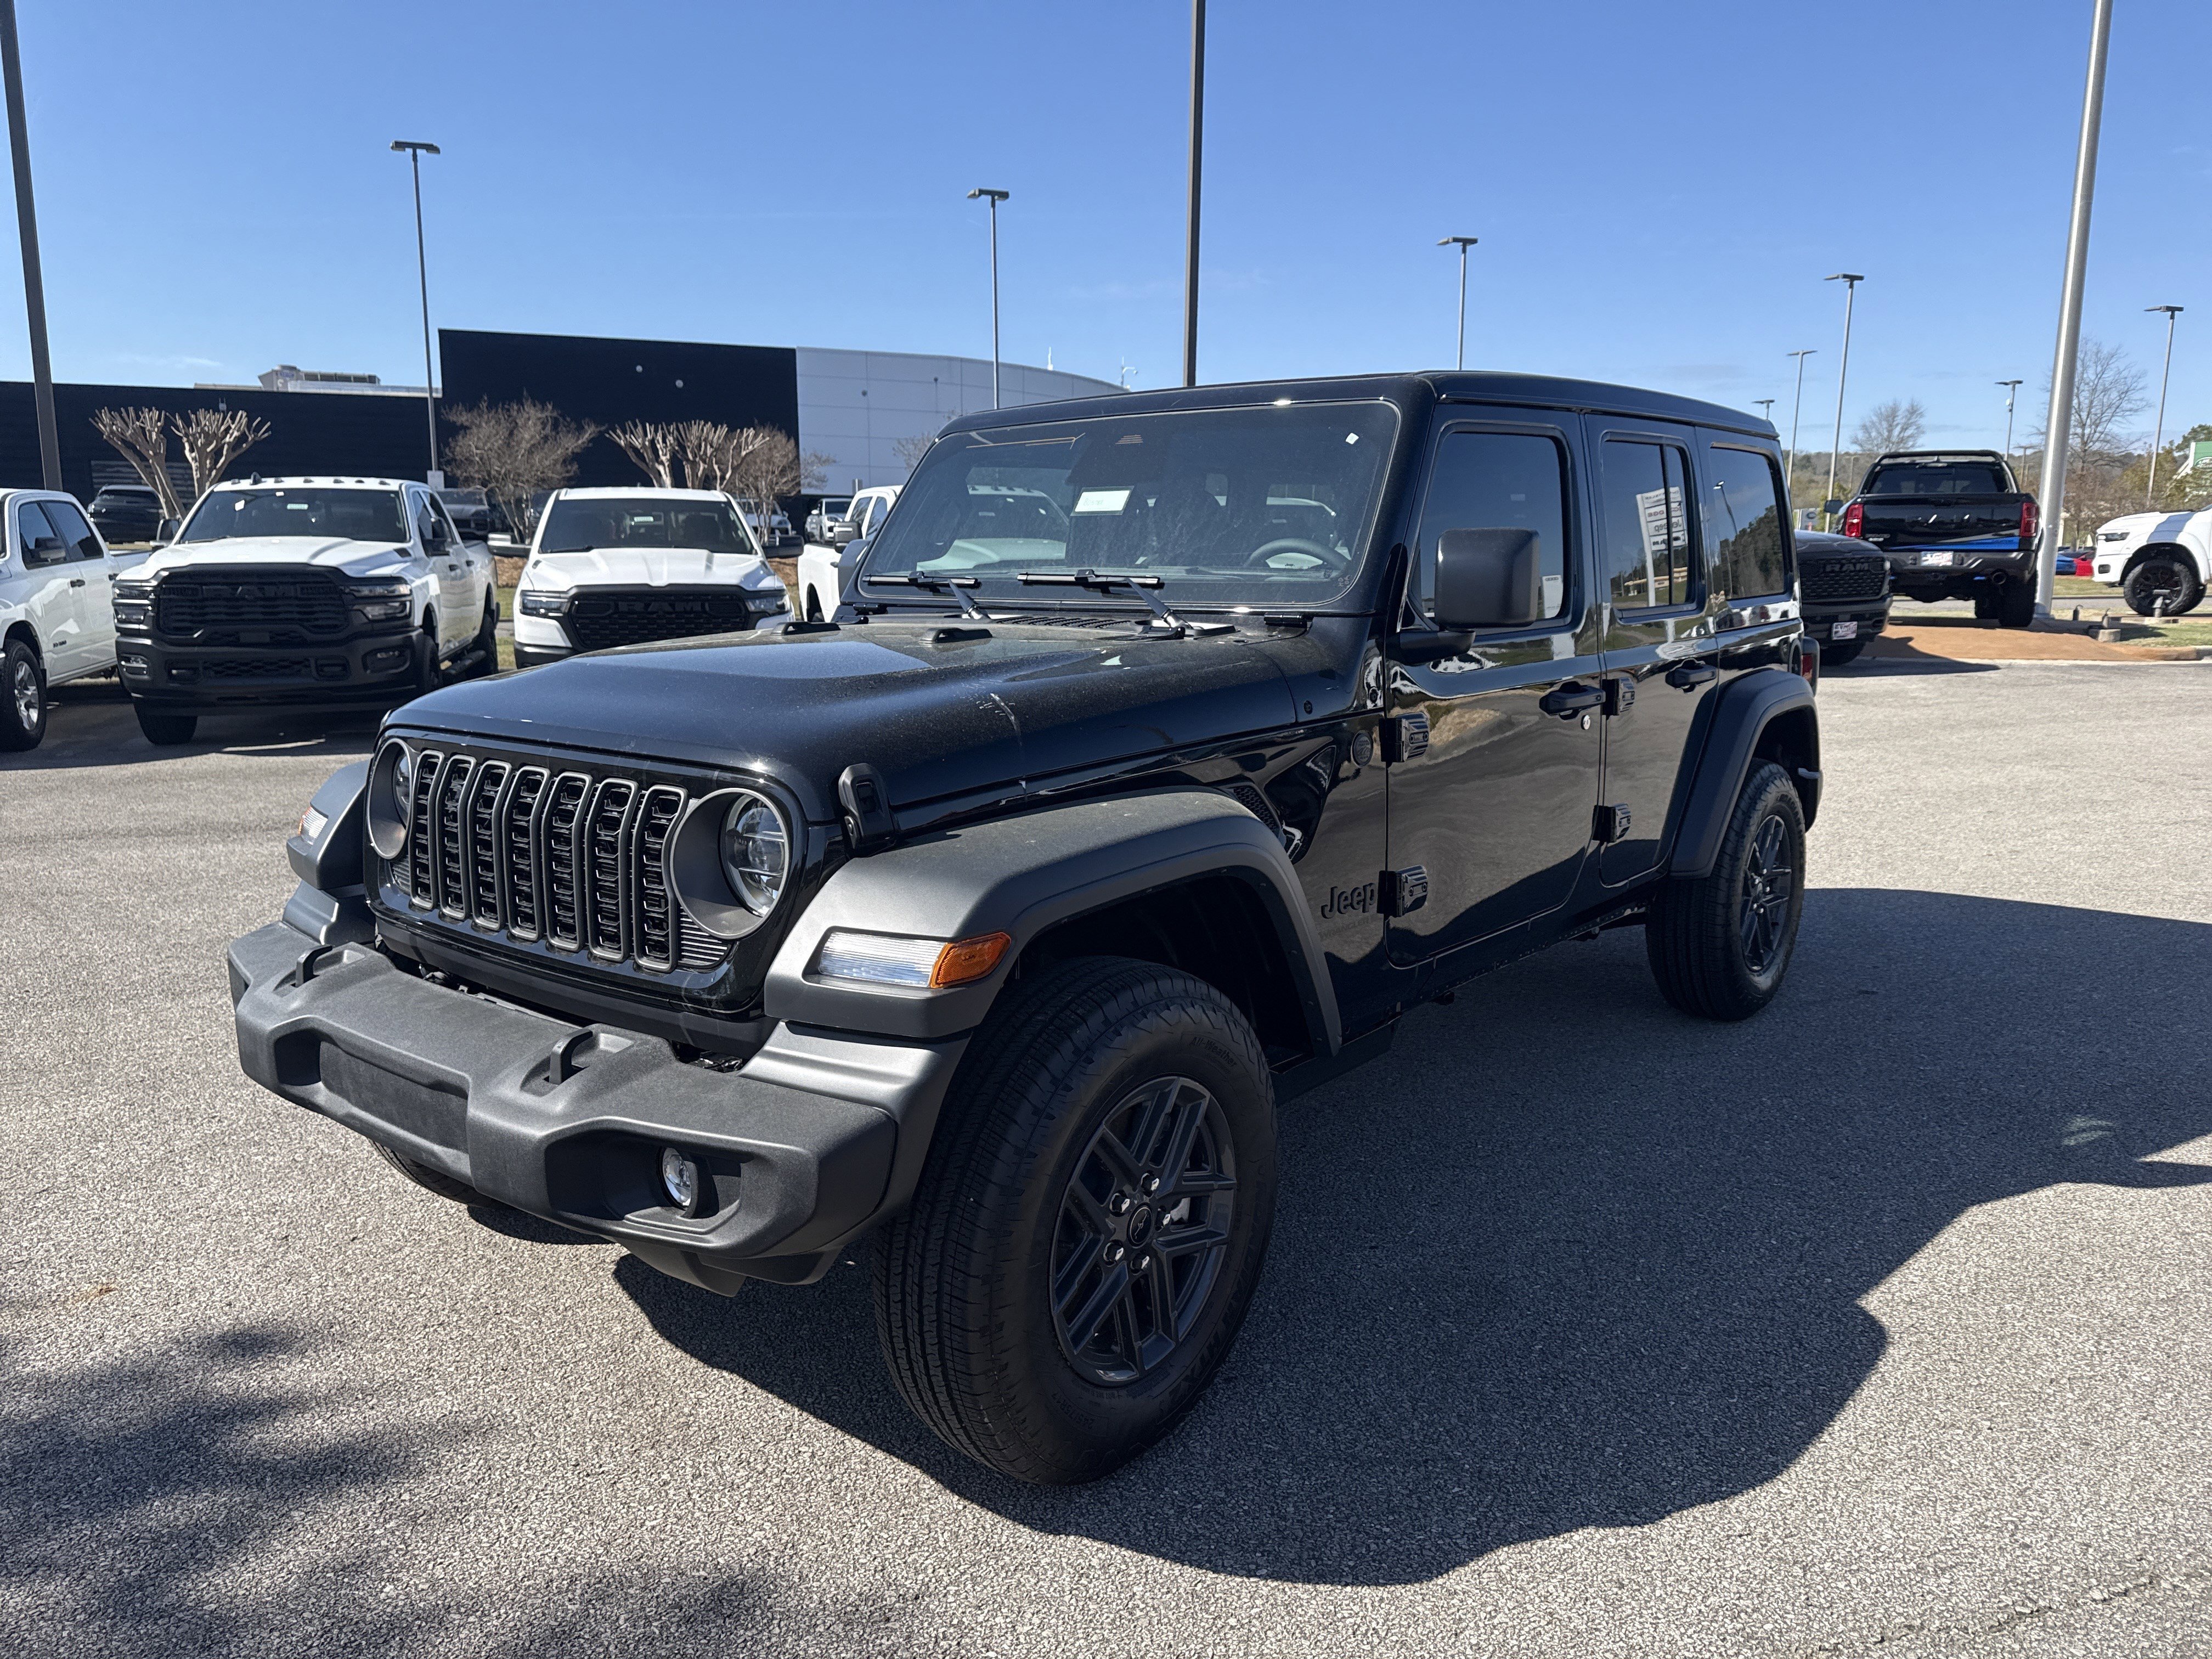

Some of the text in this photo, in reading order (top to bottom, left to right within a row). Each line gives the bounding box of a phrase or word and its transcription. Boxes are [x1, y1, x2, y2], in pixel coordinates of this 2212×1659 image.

[1826, 563, 1869, 571] RAM
[618, 602, 702, 612] RAM
[1321, 883, 1376, 919] Jeep
[1189, 1036, 1238, 1067] All-Weather
[1051, 1391, 1094, 1430] 245/75R17
